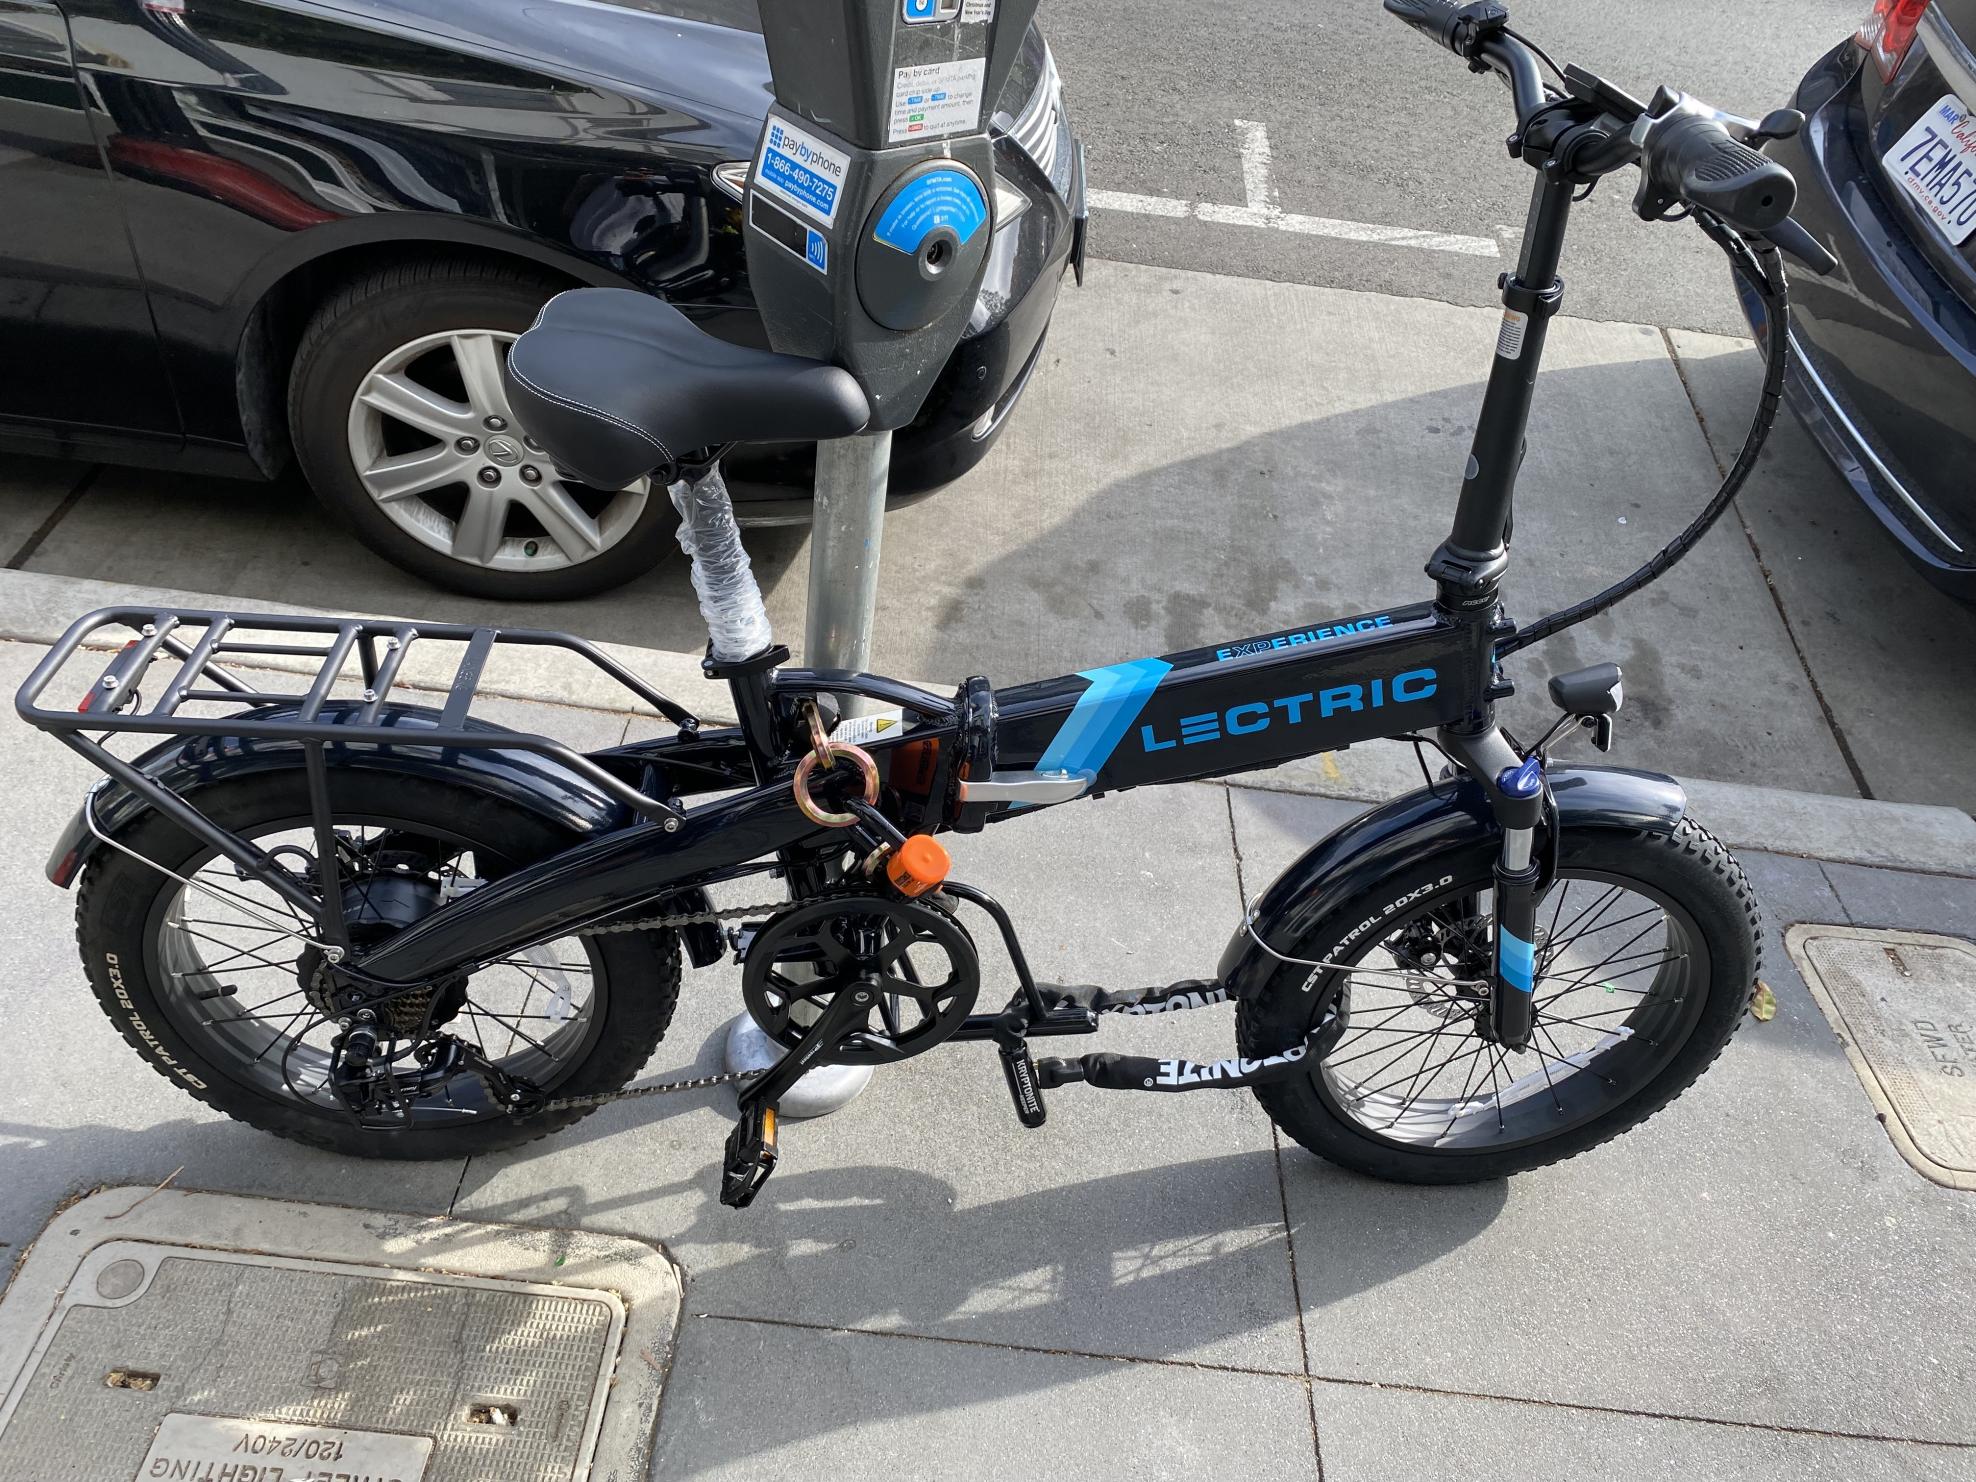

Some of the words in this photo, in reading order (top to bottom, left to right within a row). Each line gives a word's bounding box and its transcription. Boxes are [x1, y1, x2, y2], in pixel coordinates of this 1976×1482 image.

[898, 70, 912, 80] Pay
[913, 69, 922, 77] by
[923, 67, 940, 76] card
[1939, 104, 1960, 125] MAR
[766, 152, 834, 202] 1-866-490-7275
[782, 134, 842, 178] paybyphone
[784, 179, 829, 211] paybyphone.com
[1907, 176, 1948, 221] dmv.ca.gov
[1216, 615, 1394, 662] EXPERIENCE
[1141, 668, 1438, 753] LECTRIC
[1301, 964, 1325, 993] CST
[1321, 914, 1383, 965] PATROL
[1382, 874, 1454, 915] 20X3.0
[105, 952, 135, 1010] 20X3.0
[128, 1011, 179, 1066] PATROL
[1911, 1020, 1966, 1078] SFWD
[173, 1066, 208, 1091] CST
[1016, 1058, 1039, 1114] KRYPTONITE
[232, 1433, 344, 1462] 120/240V
